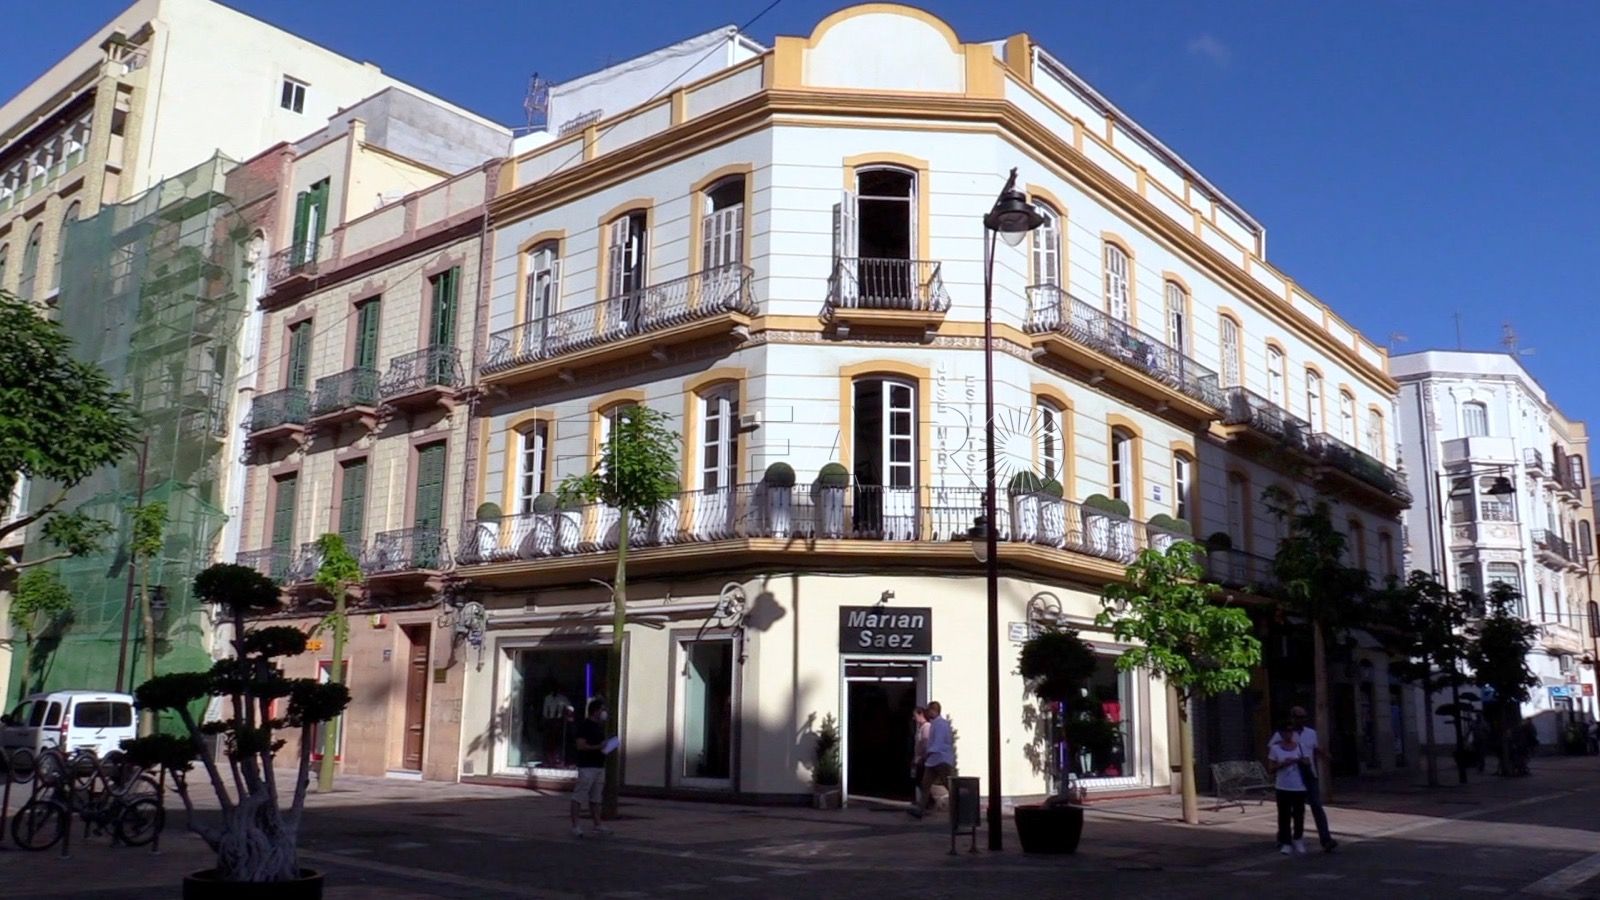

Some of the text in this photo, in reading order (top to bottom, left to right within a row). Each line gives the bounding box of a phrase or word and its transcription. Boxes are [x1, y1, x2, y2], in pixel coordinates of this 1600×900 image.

[936, 361, 948, 505] JOSE MARTIN
[964, 376, 977, 491] ESTILISTA
[848, 610, 925, 628] Marian
[858, 630, 914, 648] Saez
